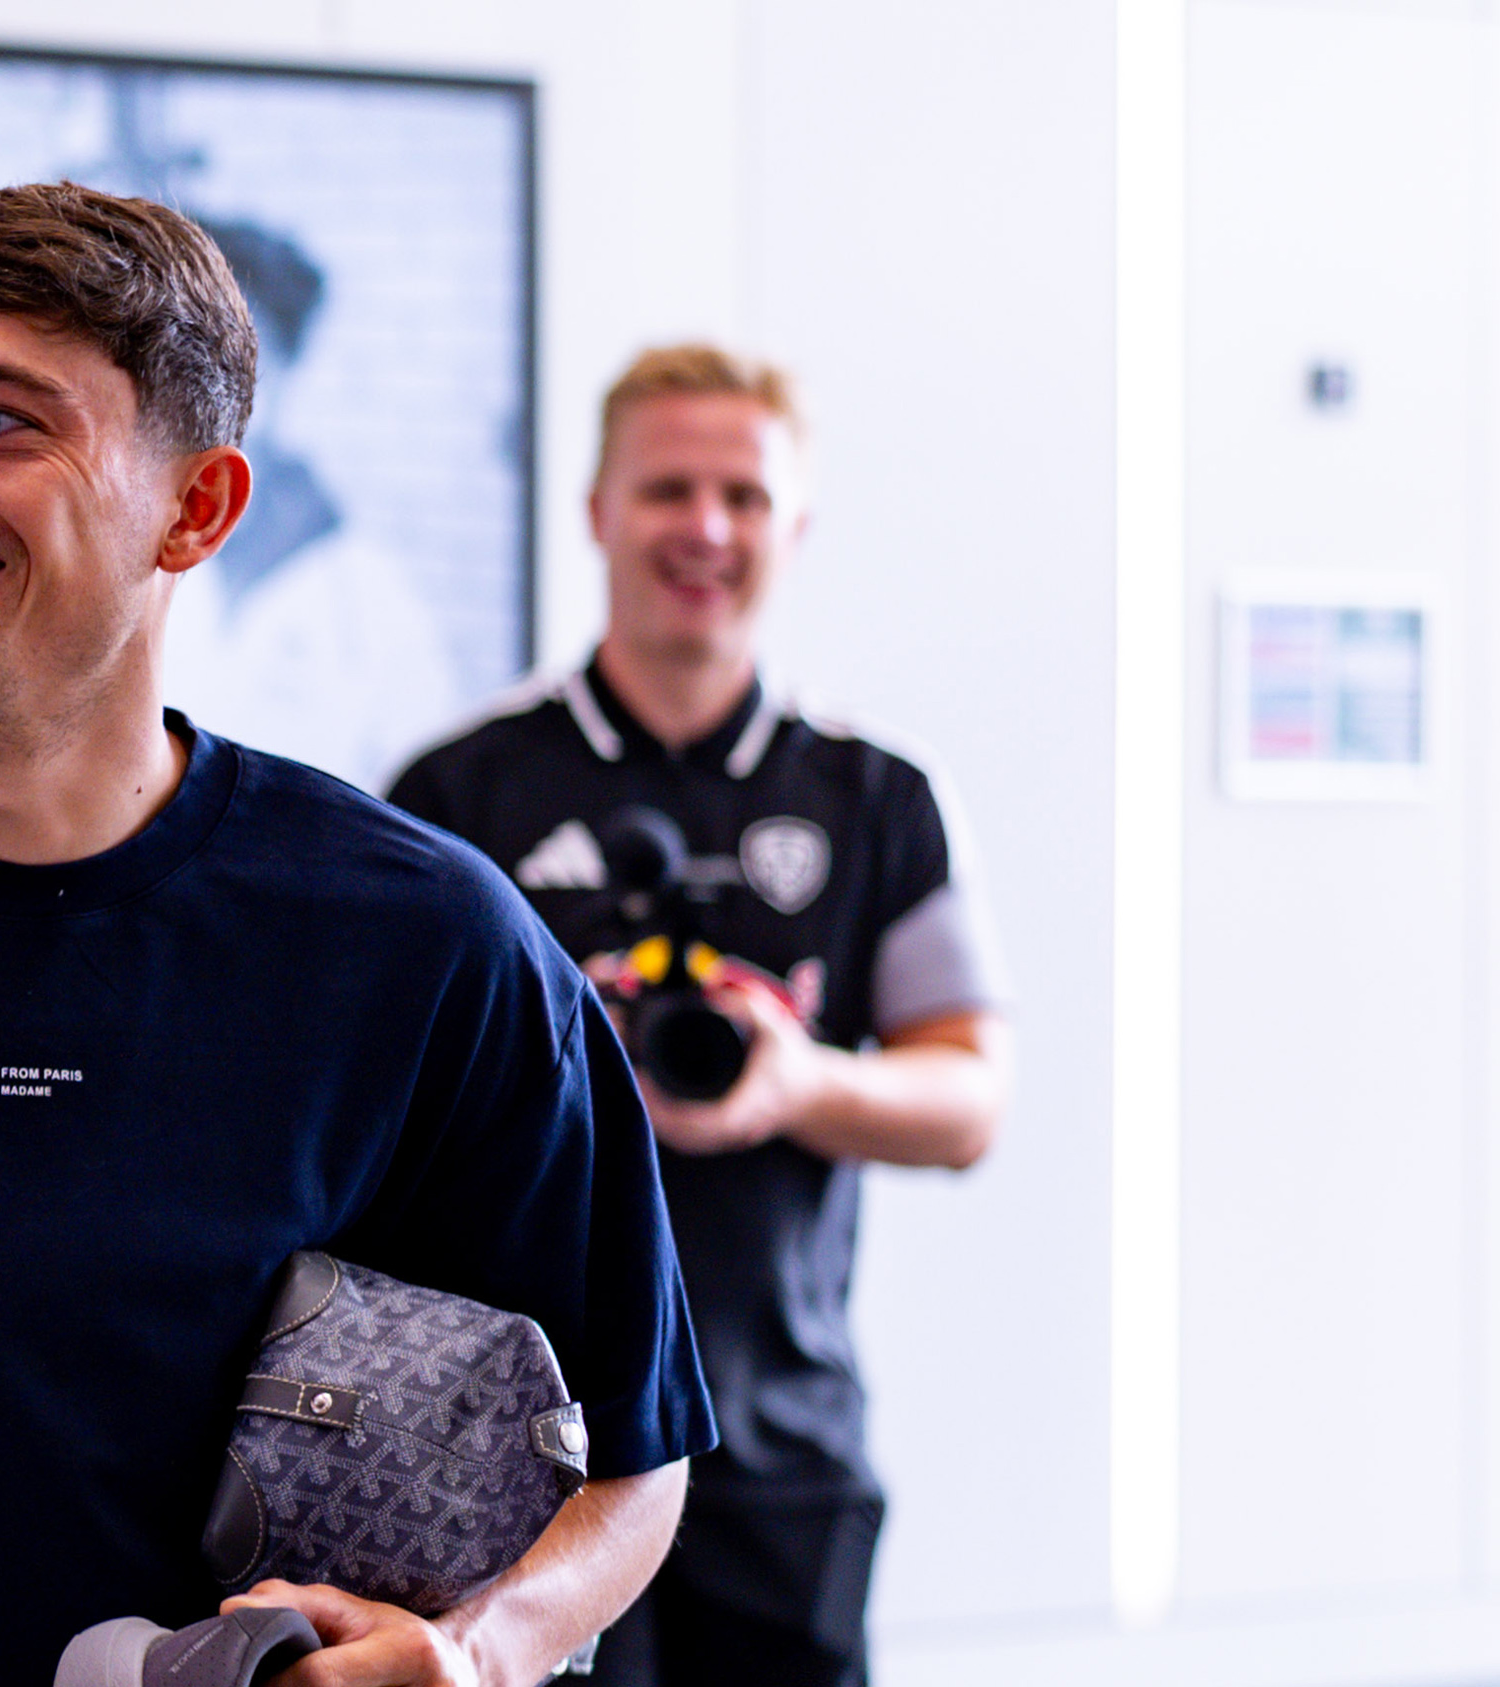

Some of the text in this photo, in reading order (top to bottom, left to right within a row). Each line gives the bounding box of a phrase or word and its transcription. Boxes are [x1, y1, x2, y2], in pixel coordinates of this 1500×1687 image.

[0, 1067, 40, 1080] FROM
[43, 1068, 83, 1082] PARIS
[0, 1085, 52, 1097] MADAME
